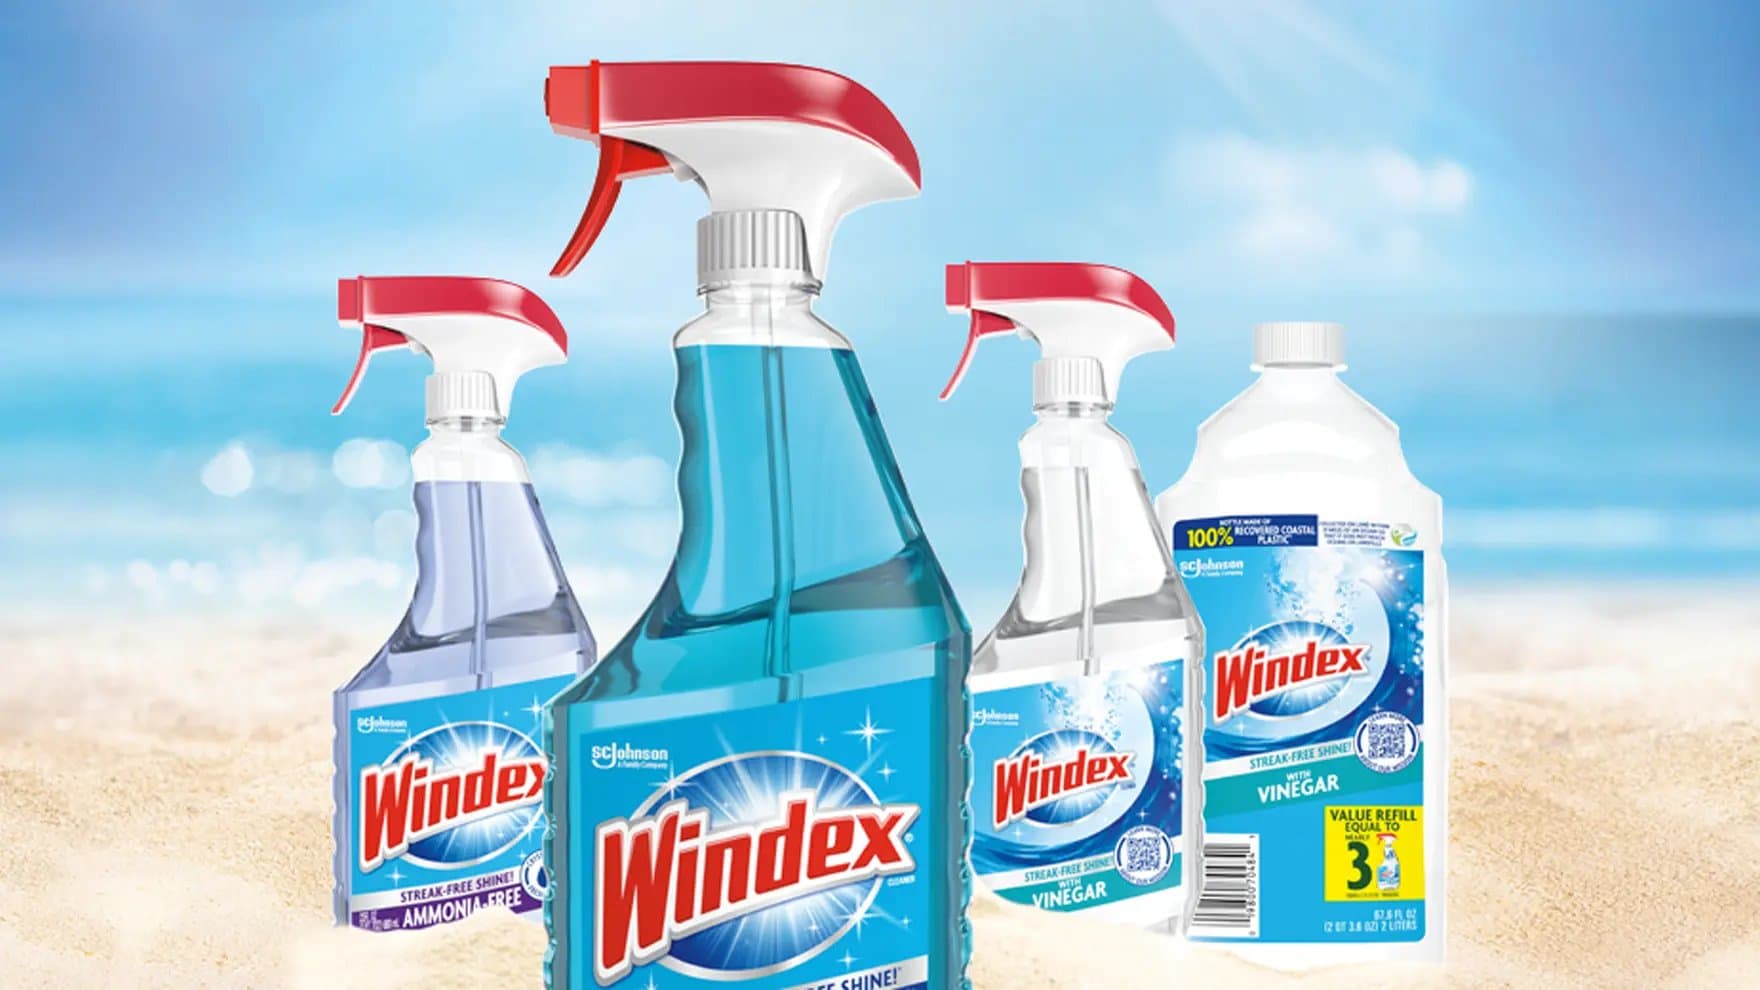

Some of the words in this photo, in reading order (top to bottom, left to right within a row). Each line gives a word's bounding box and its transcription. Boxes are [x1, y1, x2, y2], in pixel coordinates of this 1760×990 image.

[1187, 527, 1234, 548] 100%
[1234, 525, 1279, 536] RECOVERED
[1281, 525, 1316, 535] COASTAL
[1216, 641, 1364, 719] Windex
[1249, 747, 1315, 770] STREAK-FREE
[1286, 769, 1311, 781] WITH
[996, 749, 1129, 825] Windex
[1257, 774, 1340, 804] VINEGAR
[364, 753, 547, 863] Windex
[1330, 809, 1373, 821] VALUE
[1375, 809, 1418, 821] REFILL
[1345, 822, 1382, 833] EQUAL
[1385, 821, 1401, 831] TO
[1024, 864, 1081, 882] STREAK-FREE
[1346, 841, 1373, 891] 3
[401, 881, 473, 903] STREAK-FREE
[475, 871, 515, 890] SHINE!
[601, 799, 905, 971] Windex
[1032, 880, 1107, 908] VINEGAR
[1058, 877, 1082, 889] WITH
[1380, 920, 1387, 931] 2
